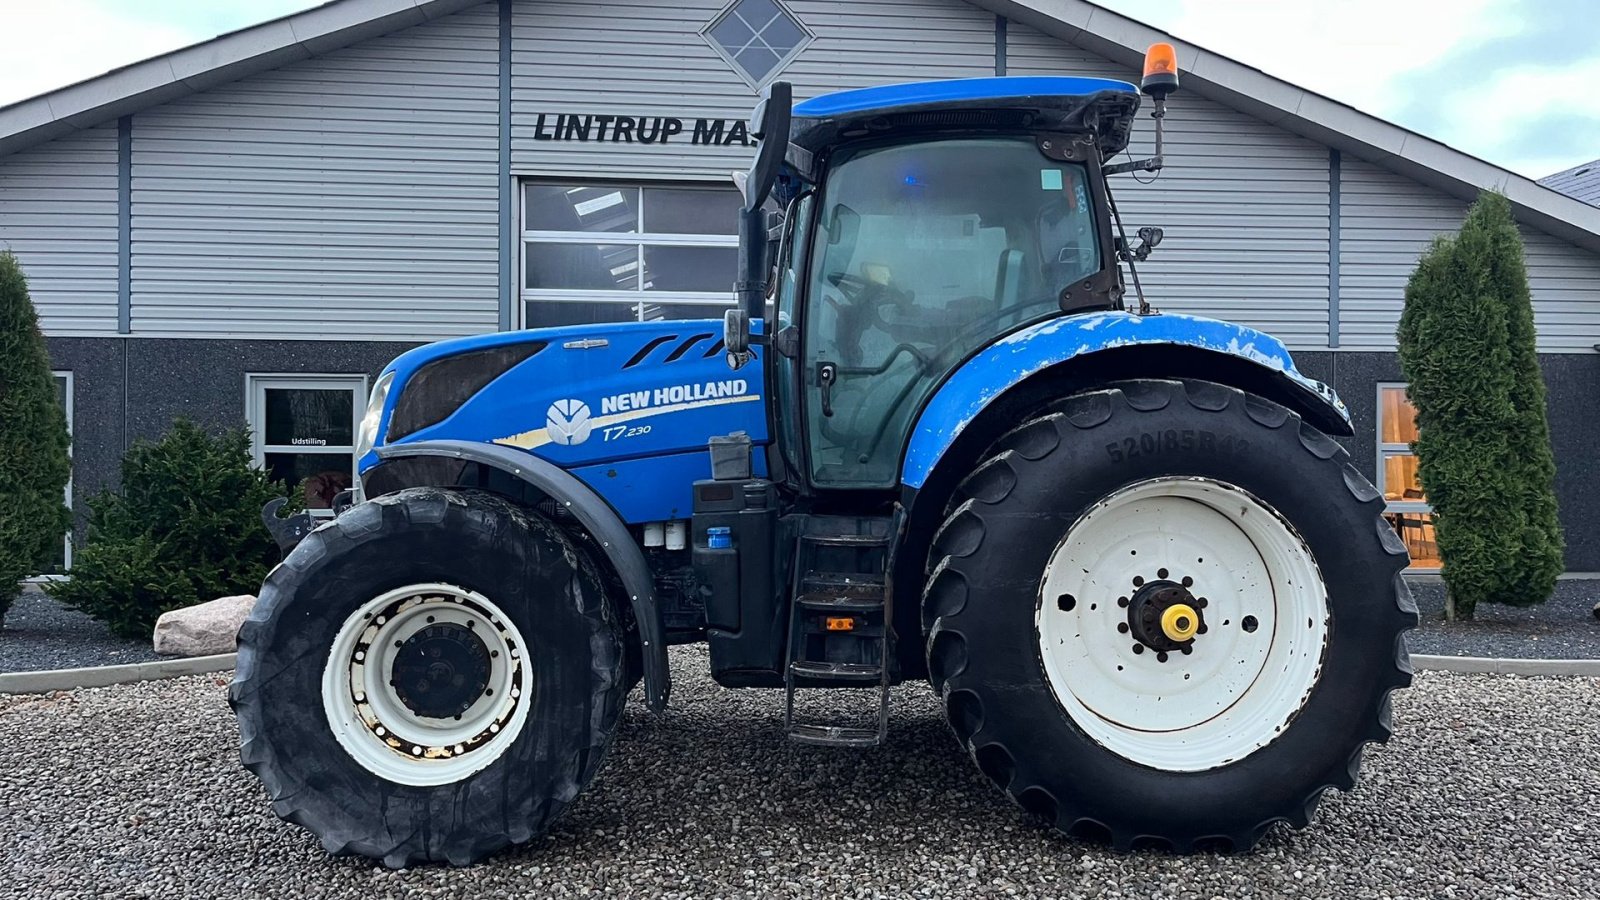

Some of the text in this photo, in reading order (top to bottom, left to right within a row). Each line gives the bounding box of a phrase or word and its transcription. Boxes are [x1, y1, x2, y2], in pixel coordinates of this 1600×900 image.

[534, 113, 758, 147] LINTRUP MA
[602, 379, 747, 414] NEW HOLLAND
[291, 438, 327, 446] Udstilling
